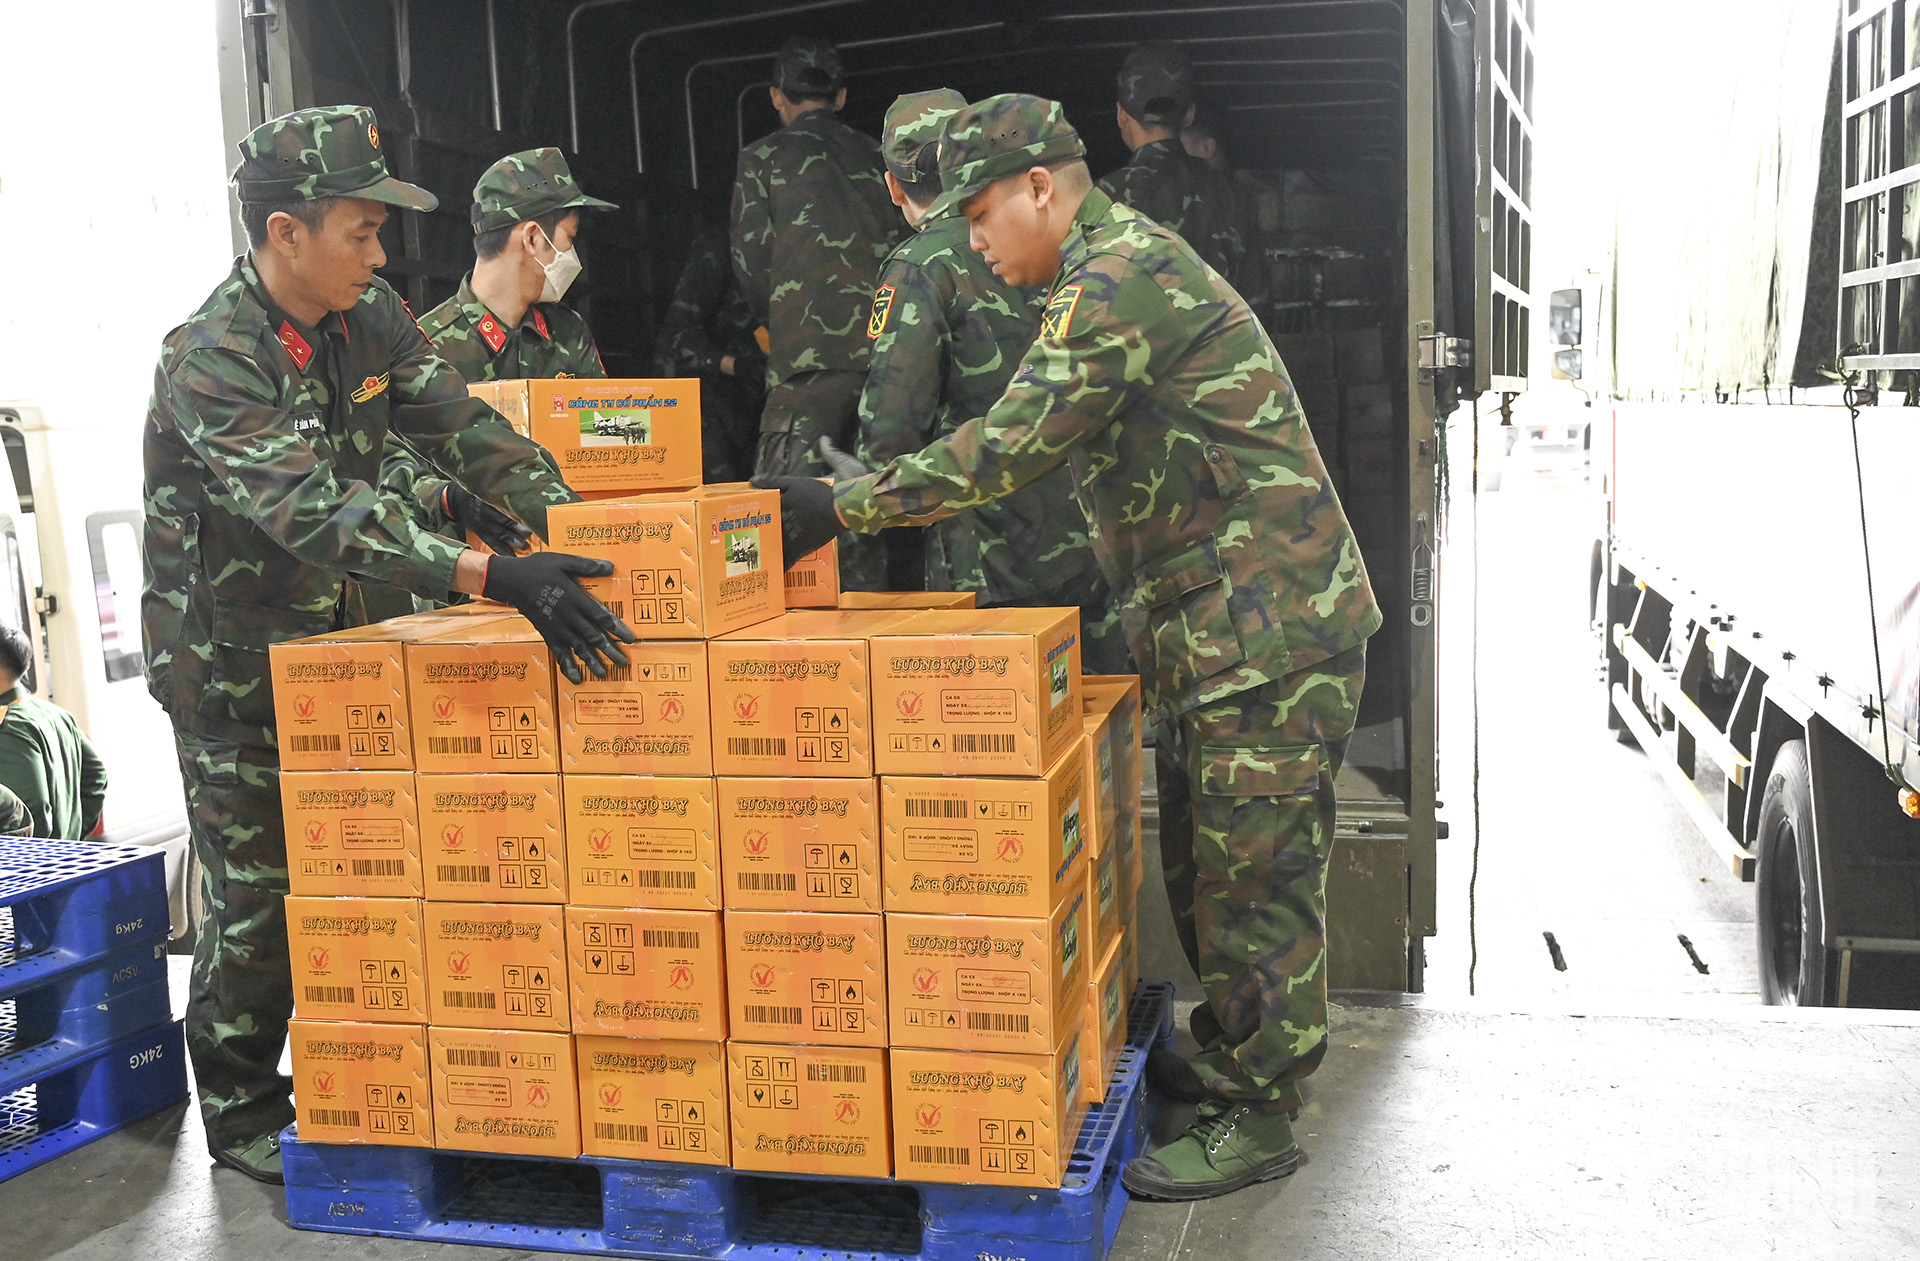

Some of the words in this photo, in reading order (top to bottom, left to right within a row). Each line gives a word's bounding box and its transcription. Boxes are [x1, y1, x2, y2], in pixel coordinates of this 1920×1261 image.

[568, 396, 599, 409] CÔNG
[600, 399, 615, 408] TY
[616, 395, 632, 408] CỔ
[633, 394, 662, 409] PHẦN
[664, 398, 677, 407] 22
[566, 449, 610, 462] LƯƠNG
[611, 446, 640, 464] KHÔ
[642, 448, 666, 463] BAY
[567, 524, 612, 540] LƯƠNG
[613, 521, 644, 542] KHÔ
[646, 524, 673, 542] BAY
[287, 663, 328, 678] LƯƠNG
[330, 659, 357, 680] KHÔ
[358, 661, 383, 680] BAY
[426, 663, 470, 678] LƯƠNG
[472, 660, 500, 681] KHÔ
[501, 662, 527, 681] BAY
[728, 660, 777, 676] LƯƠNG
[779, 658, 810, 680] KHÔ
[811, 661, 841, 680] BAY
[890, 657, 942, 672] LƯƠNG
[944, 653, 976, 675] KHÔ
[978, 657, 1008, 675] BAY
[582, 736, 609, 754] BAY
[611, 736, 640, 757] KHÔ
[642, 740, 690, 755] LƯƠNG
[297, 790, 340, 803] LƯƠNG
[341, 787, 368, 807] KHÔ
[369, 790, 395, 807] BAY
[435, 793, 479, 807] LƯƠNG
[480, 790, 509, 811] KHÔ
[510, 793, 536, 811] BAY
[582, 796, 629, 811] LƯƠNG
[630, 794, 659, 815] KHÔ
[661, 798, 688, 816] BAY
[737, 797, 786, 812] LƯƠNG
[787, 795, 818, 817] KHÔ
[820, 799, 849, 817] BAY
[910, 873, 940, 891] BAY
[941, 874, 974, 896] KHÔ
[975, 879, 1028, 895] LƯƠNG
[115, 918, 143, 935] 24Kg
[301, 917, 343, 930] LƯƠNG
[344, 915, 371, 935] KHÔ
[372, 918, 397, 935] BAY
[441, 921, 485, 934] LƯƠNG
[486, 920, 514, 939] KHÔ
[515, 924, 541, 941] BAY
[744, 932, 792, 946] LƯƠNG
[794, 930, 825, 951] KHÔ
[826, 934, 855, 952] BAY
[907, 935, 958, 950] LƯƠNG
[959, 934, 991, 956] KHÔ
[993, 939, 1023, 958] BAY
[112, 966, 139, 984] ACSV
[592, 999, 619, 1016] BAY
[621, 1001, 650, 1021] KHÔ
[652, 1006, 699, 1020] LƯƠNG
[129, 1044, 163, 1069] 24KG
[306, 1042, 348, 1054] LƯƠNG
[350, 1040, 377, 1059] KHÔ
[378, 1044, 403, 1061] BAY
[593, 1053, 637, 1067] LƯƠNG
[639, 1053, 668, 1073] KHÔ
[669, 1058, 696, 1075] BAY
[910, 1072, 960, 1086] LƯƠNG
[962, 1070, 994, 1091] KHÔ
[996, 1075, 1026, 1093] BAY
[454, 1116, 480, 1133] BAY
[481, 1117, 509, 1138] KHÔ
[510, 1123, 555, 1138] LƯƠNG
[754, 1133, 782, 1150] BAY
[784, 1135, 814, 1155] KHÔ
[816, 1140, 865, 1154] LƯƠNG
